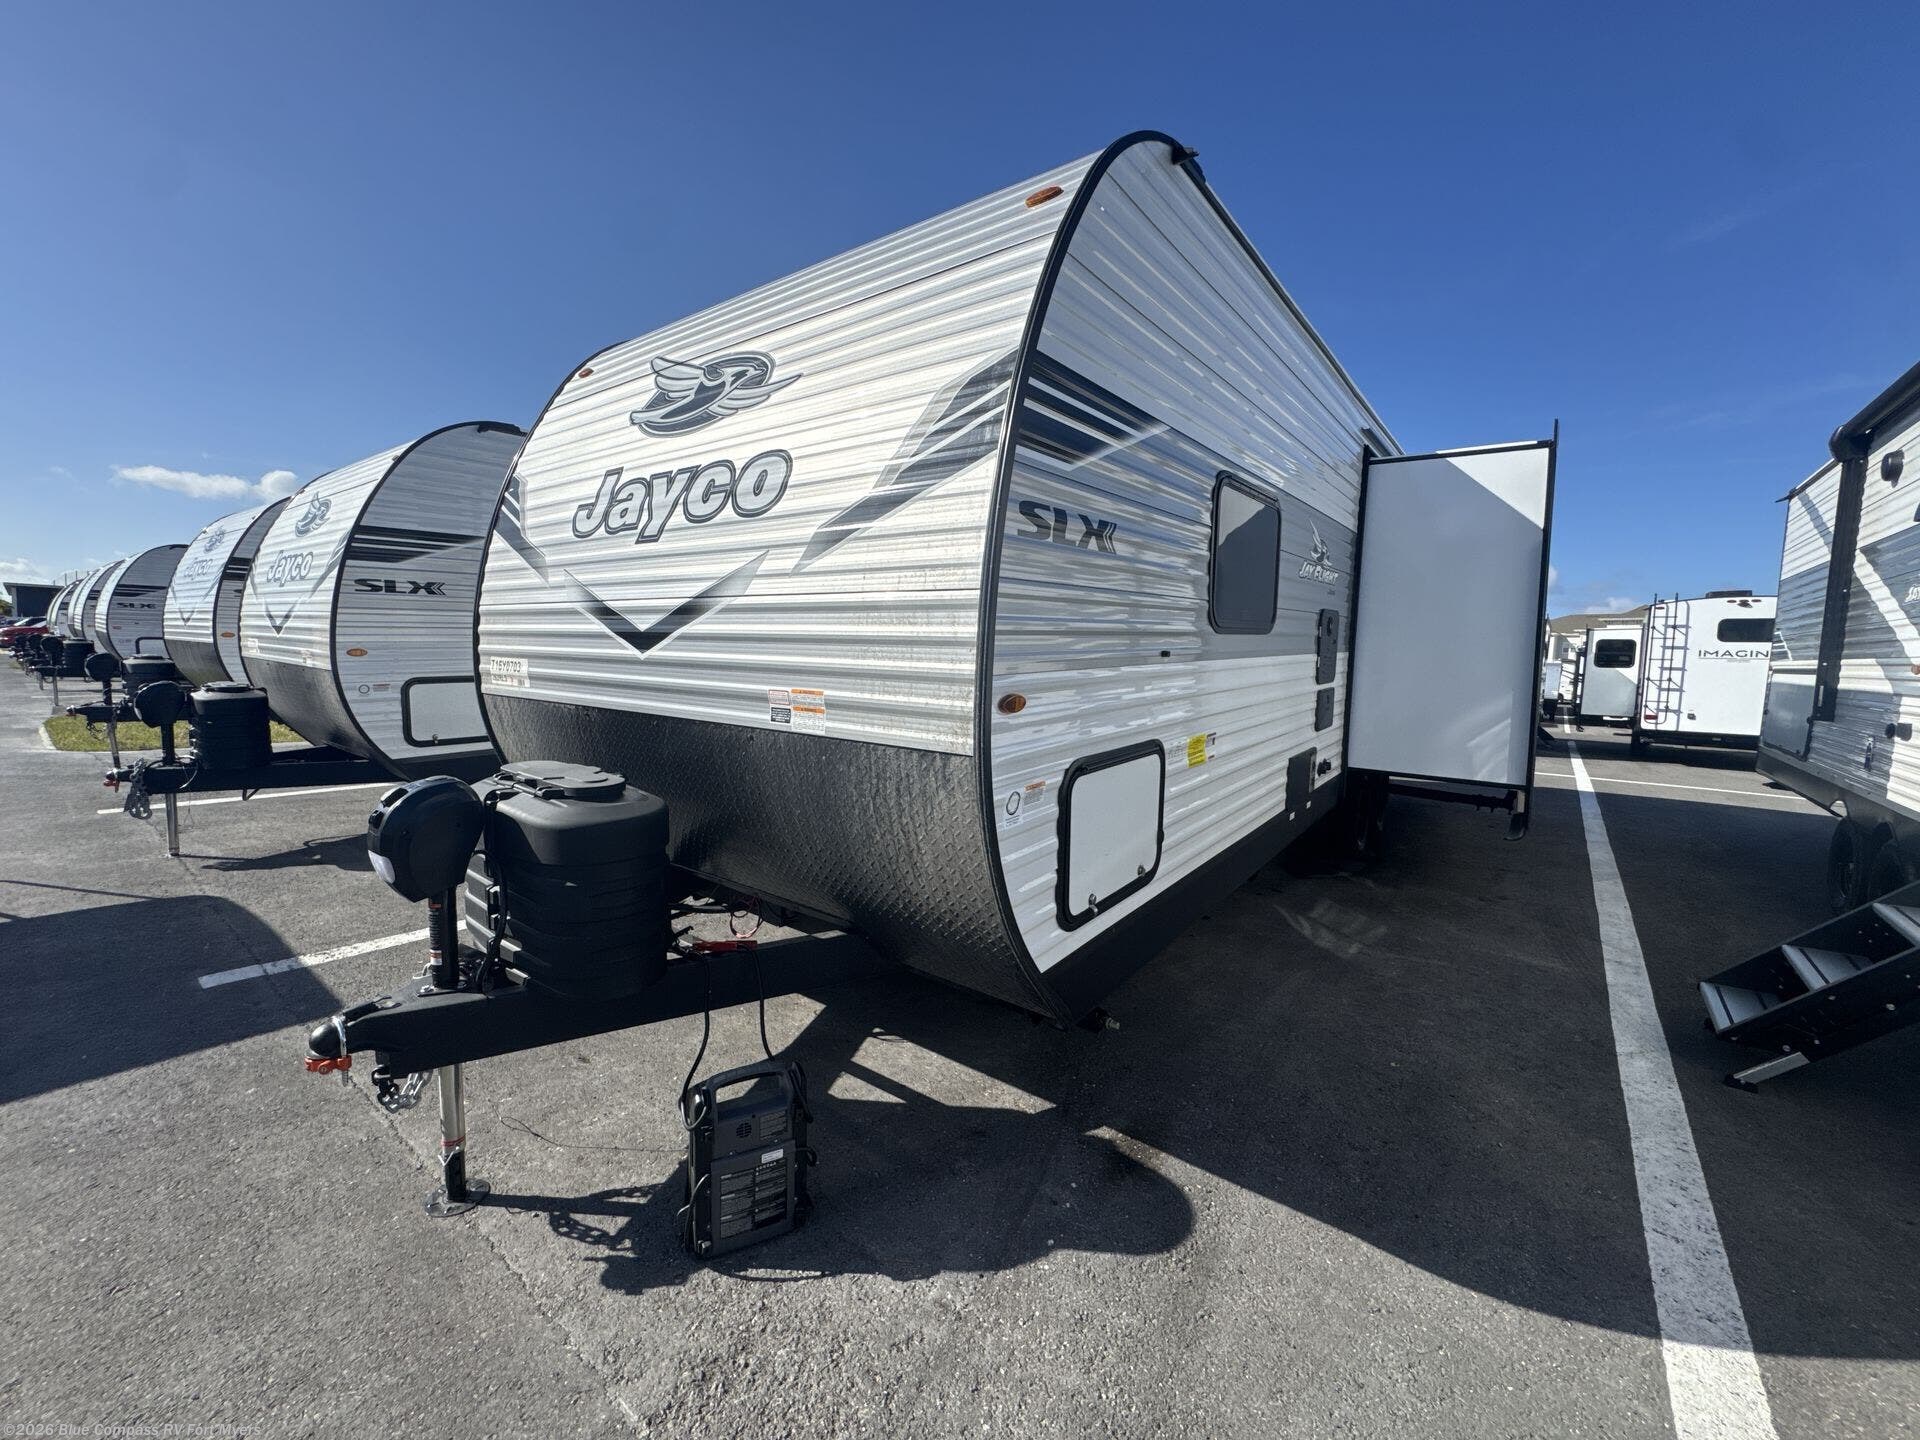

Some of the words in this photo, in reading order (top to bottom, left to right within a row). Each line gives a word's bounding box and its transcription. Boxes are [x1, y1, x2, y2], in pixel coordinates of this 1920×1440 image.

[572, 449, 794, 544] Jayco
[1017, 500, 1117, 554] SLX
[267, 550, 313, 587] Jayco
[354, 579, 445, 595] SLX
